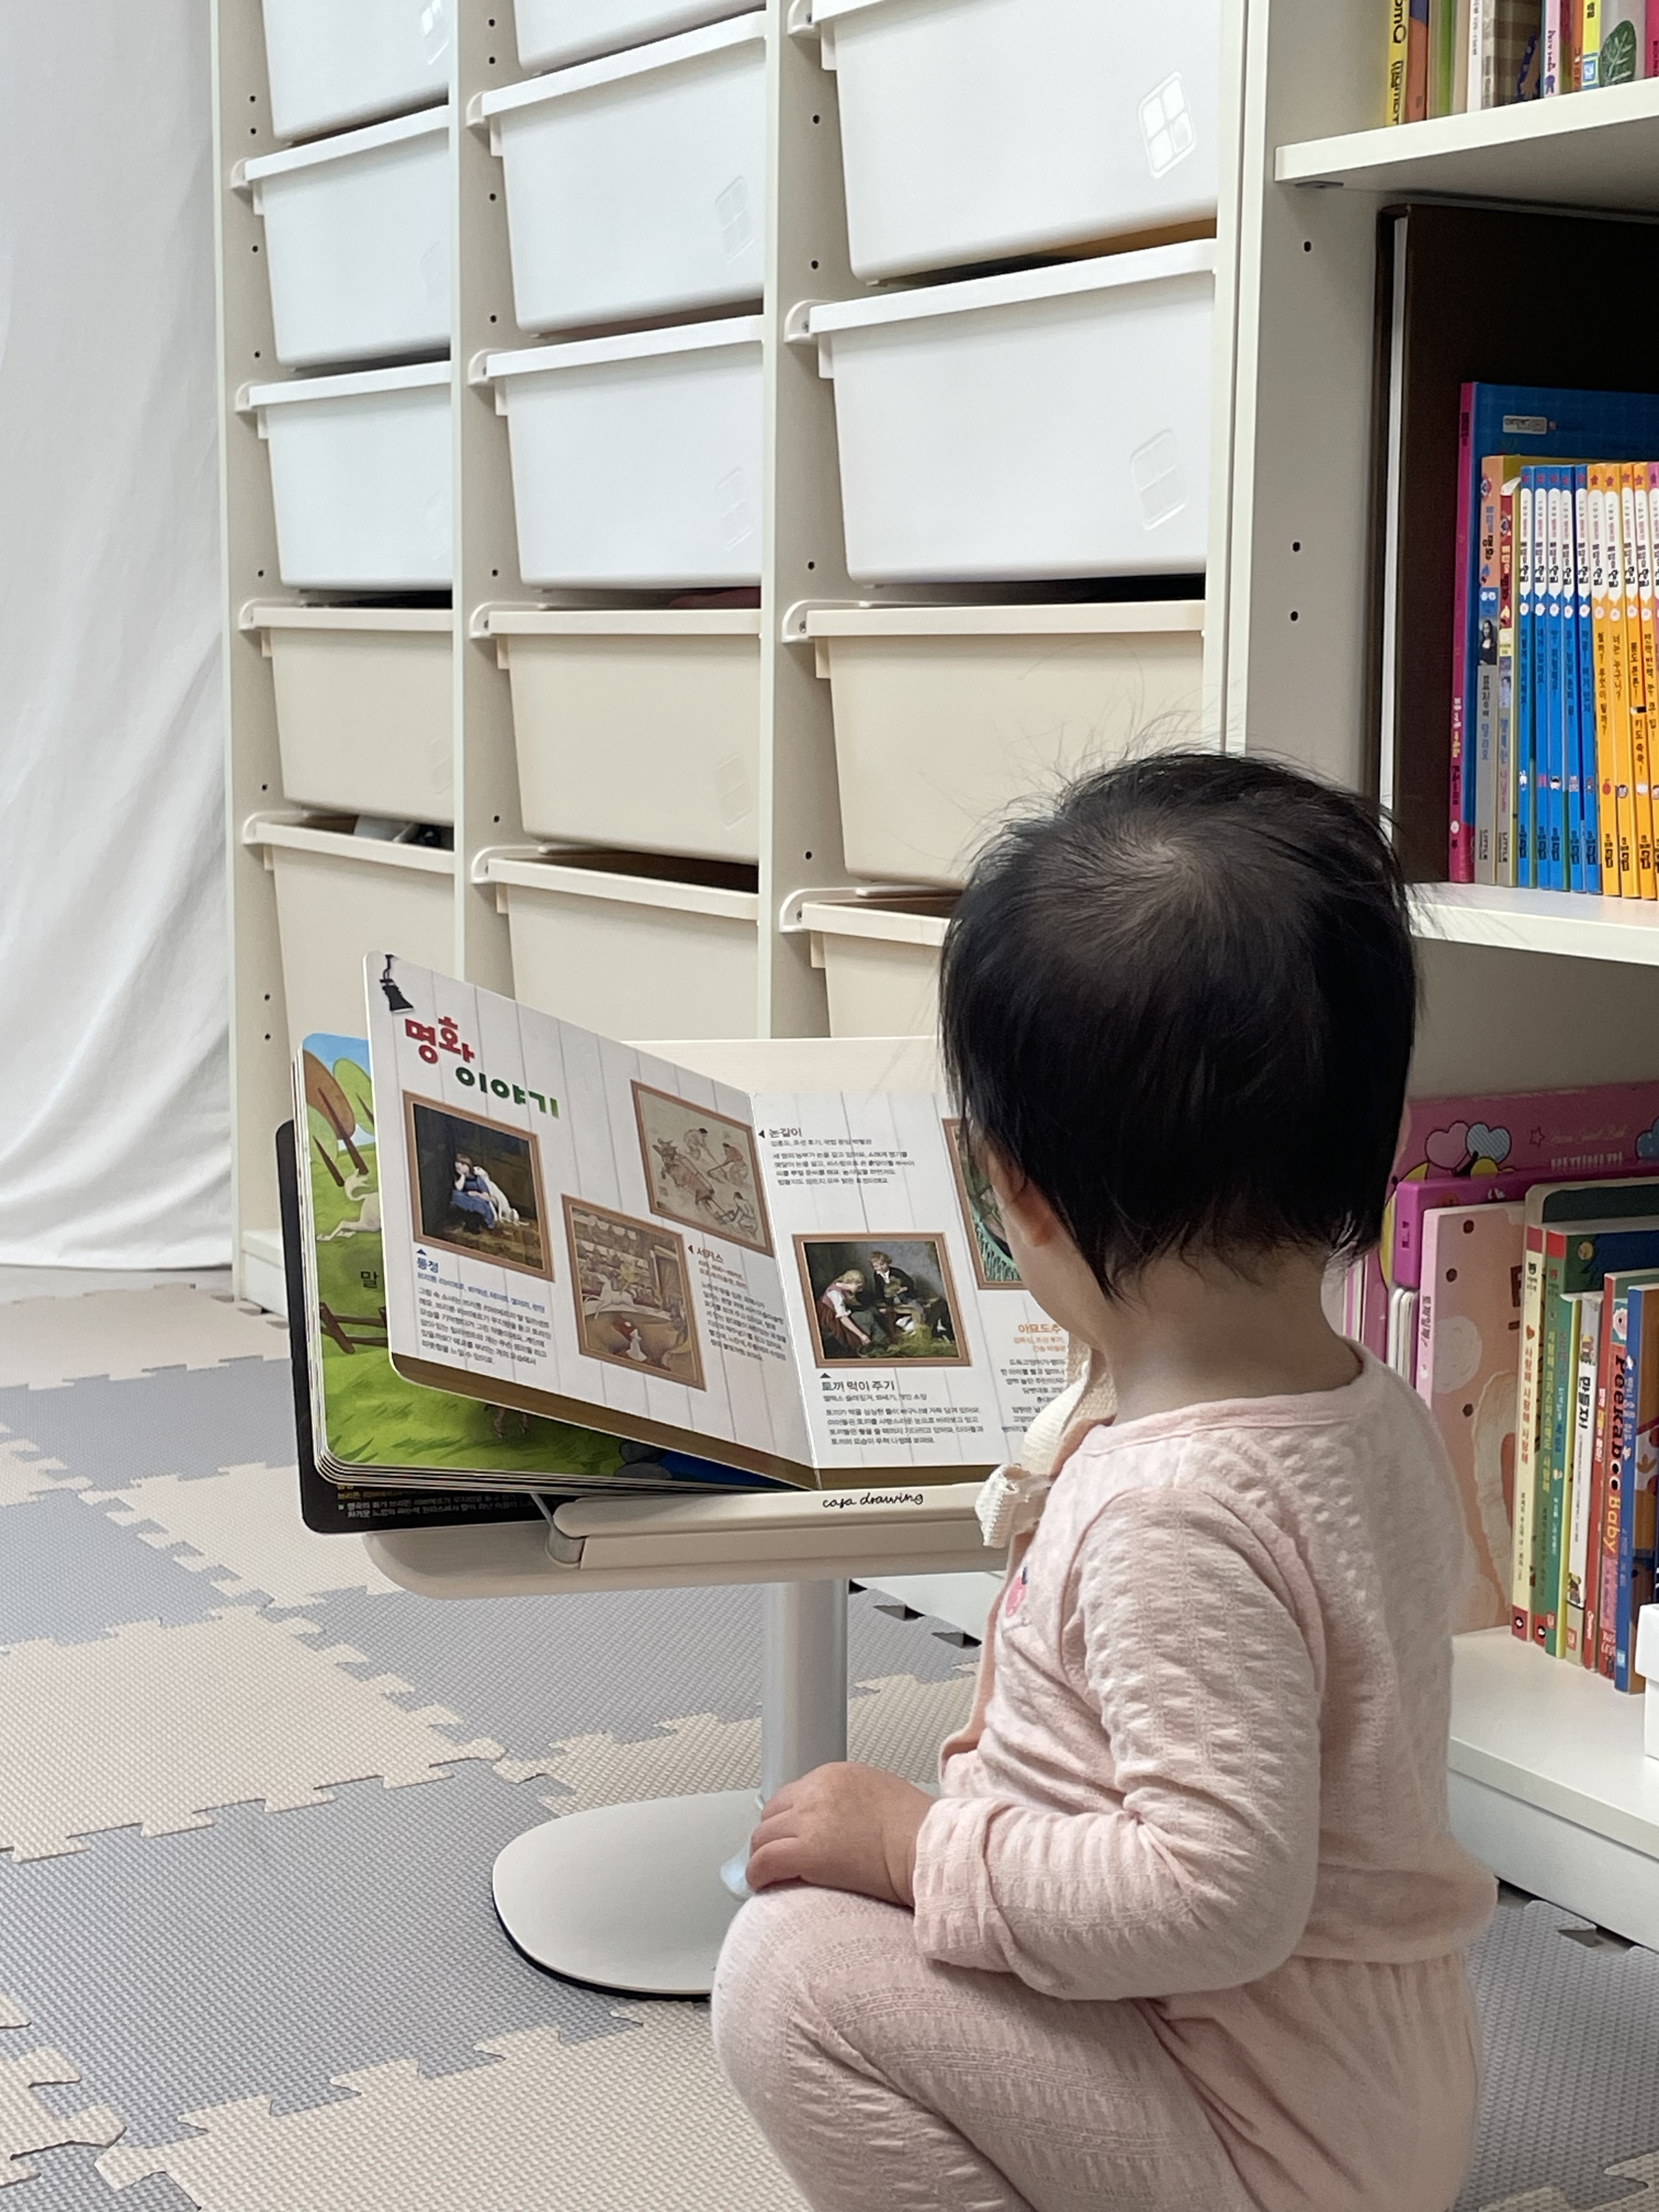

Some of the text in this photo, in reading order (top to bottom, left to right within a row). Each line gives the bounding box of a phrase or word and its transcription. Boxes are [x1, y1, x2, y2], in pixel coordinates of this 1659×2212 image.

[405, 1016, 476, 1064] 명화
[455, 1066, 559, 1119] 이야기
[769, 1127, 802, 1138] 논갈이
[822, 1380, 895, 1392] 토끼 먹이 주기
[859, 1492, 923, 1505] drawing
[1602, 1496, 1621, 1554] Baby
